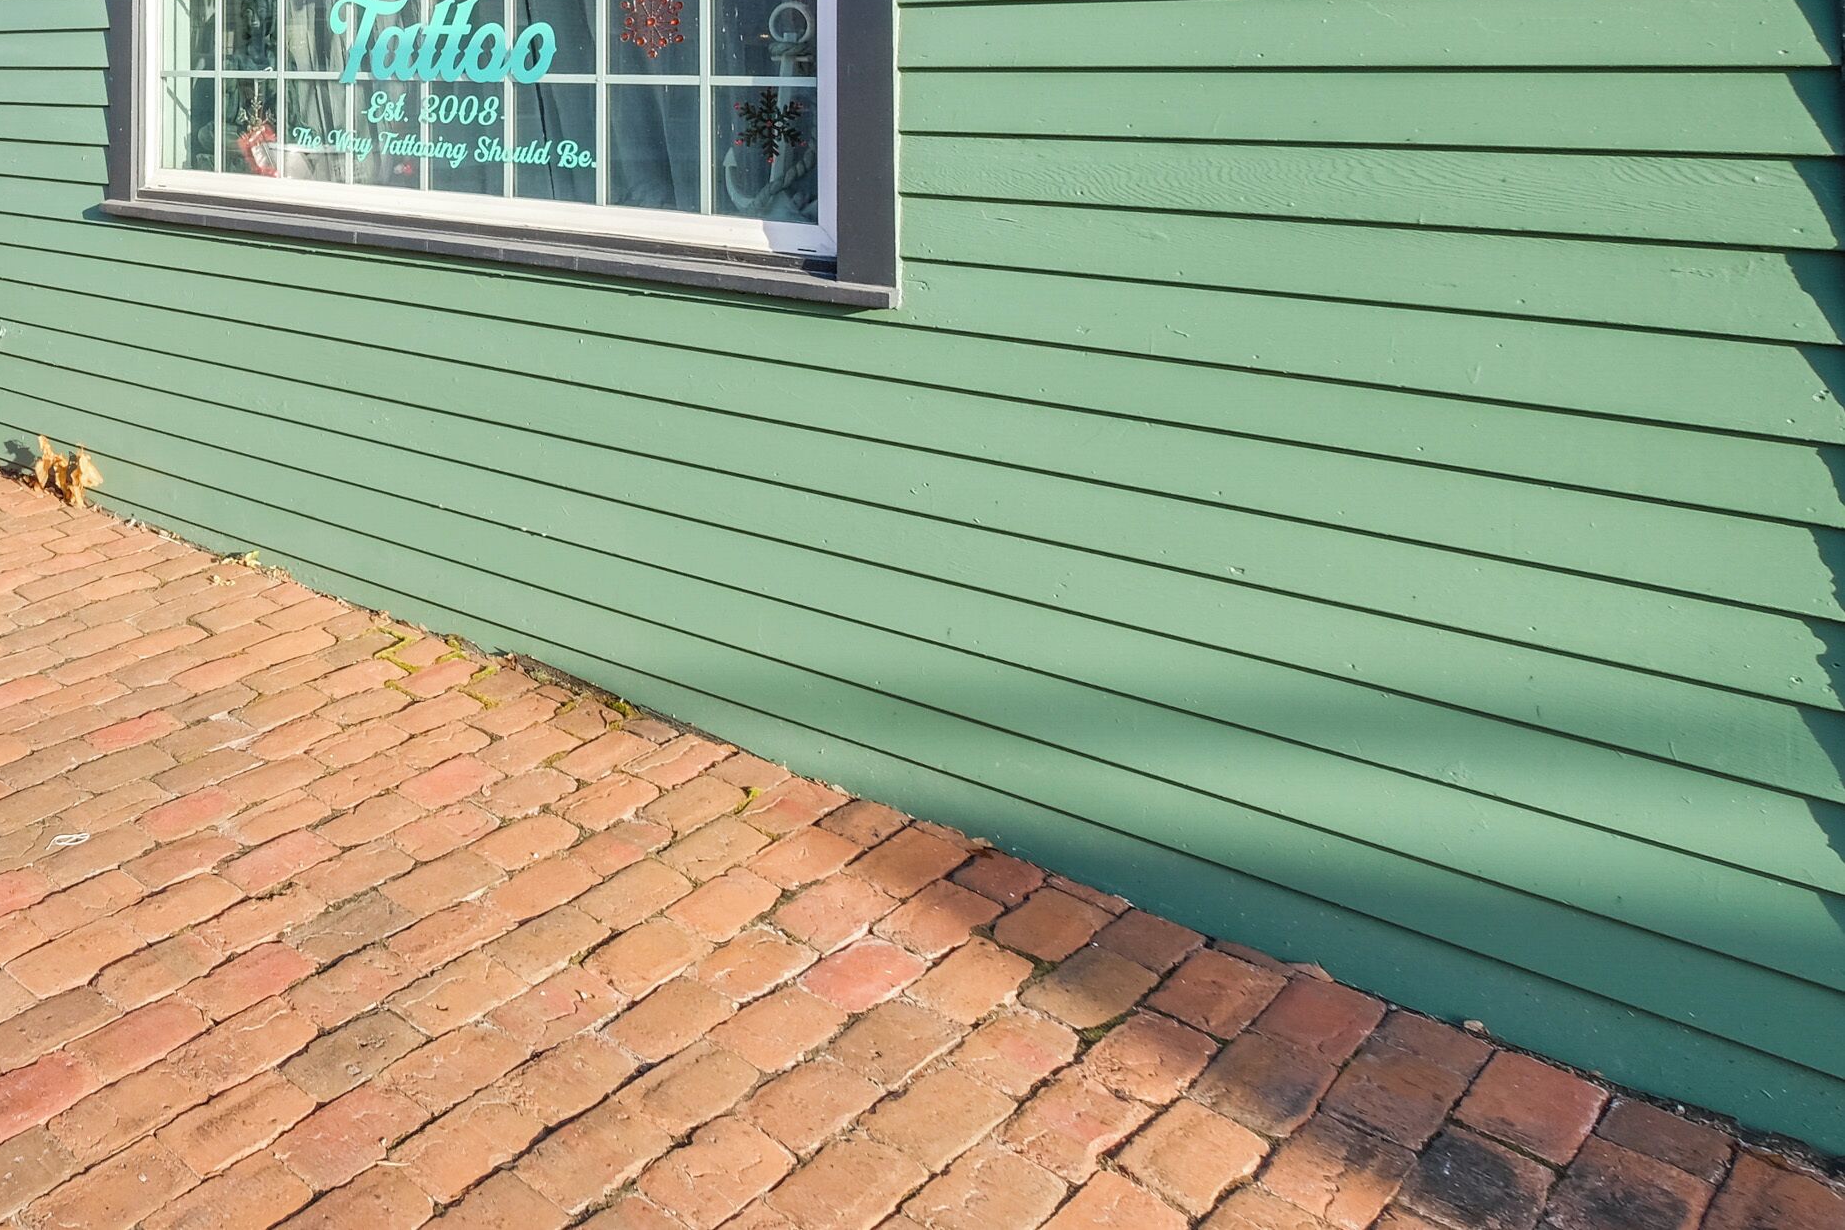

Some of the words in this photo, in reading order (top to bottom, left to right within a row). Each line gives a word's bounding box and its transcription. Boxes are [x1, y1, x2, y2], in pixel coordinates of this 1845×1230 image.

[292, 126, 323, 151] The
[327, 129, 372, 162] Way
[378, 131, 467, 168] Tattooing
[474, 135, 551, 166] Should
[557, 139, 597, 168] Be.
